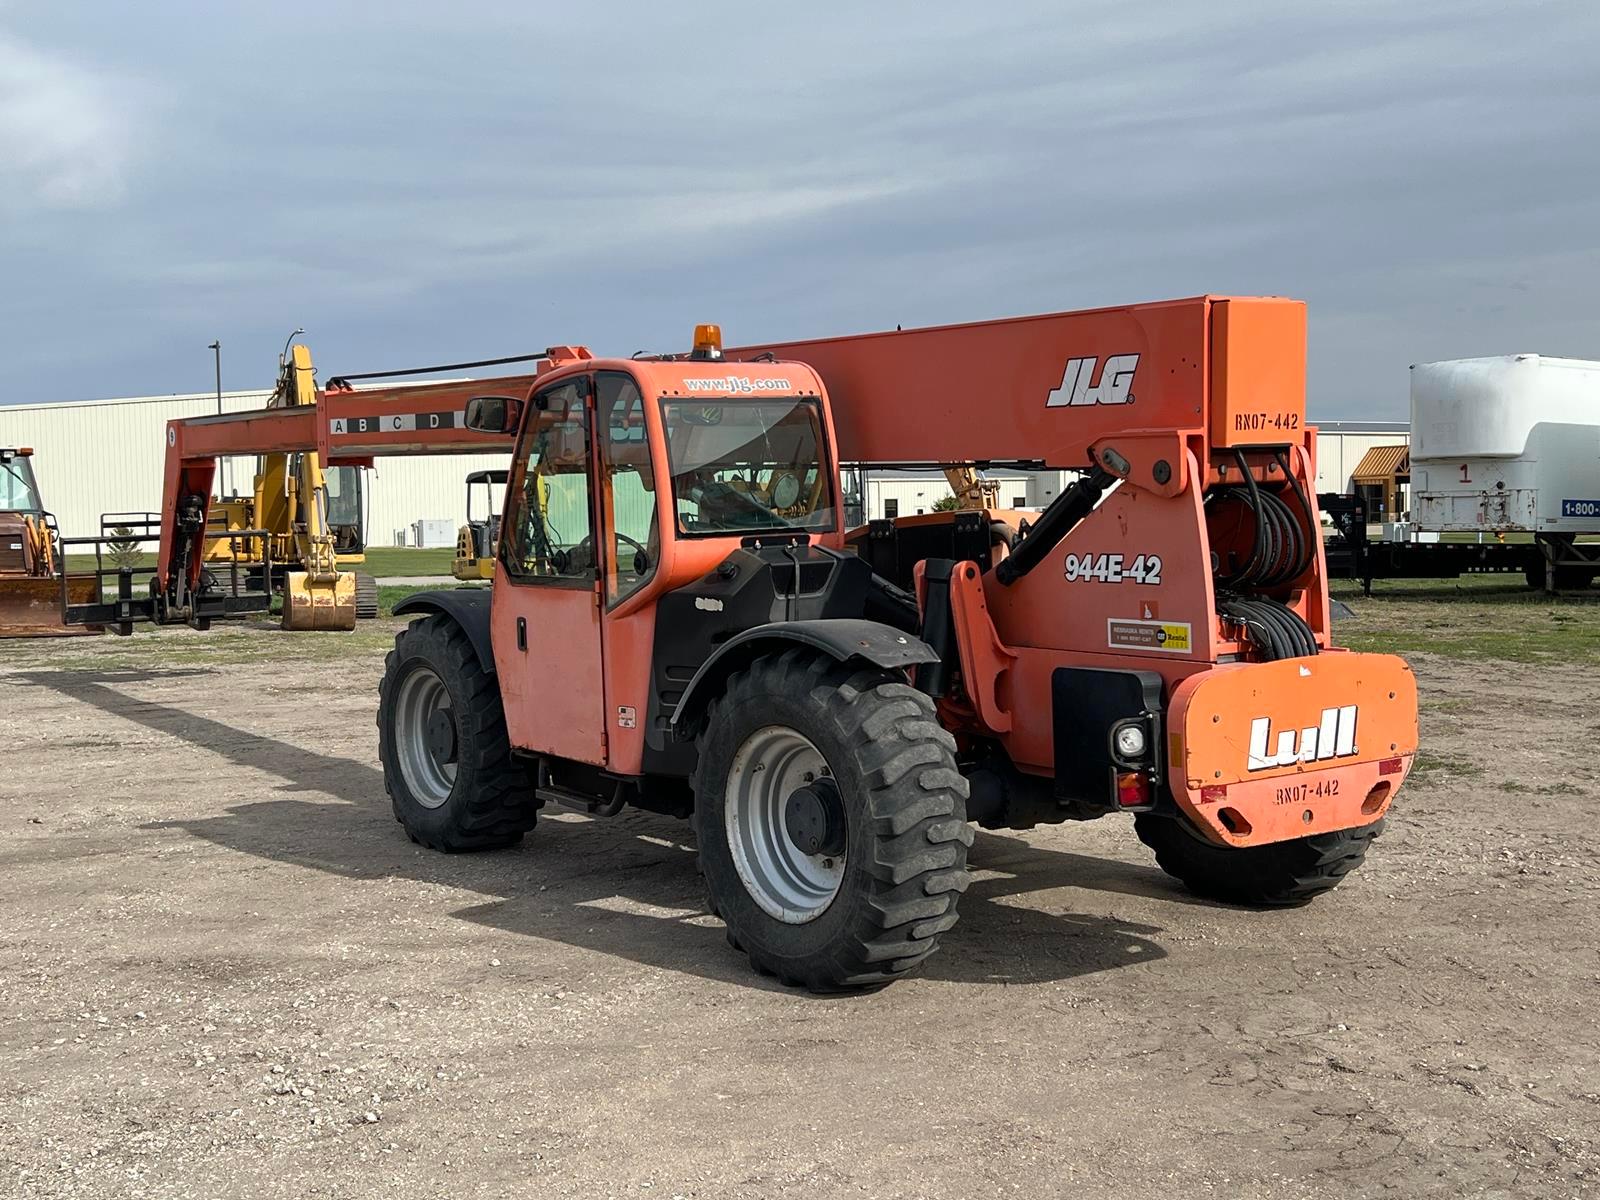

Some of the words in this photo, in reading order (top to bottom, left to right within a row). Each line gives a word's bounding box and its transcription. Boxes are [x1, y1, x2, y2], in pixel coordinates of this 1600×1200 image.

[683, 376, 791, 393] www.jlg.com
[1045, 353, 1141, 408] JLG
[335, 420, 343, 432] A
[359, 419, 367, 431] B
[393, 417, 402, 429] C
[429, 414, 439, 428] D
[1235, 413, 1298, 430] RN07-442
[1460, 464, 1472, 483] 1
[1565, 503, 1600, 515] 1-800-
[1064, 553, 1162, 585] 944E-42
[1247, 705, 1358, 773] Lull
[1276, 780, 1339, 805] RN07-442
